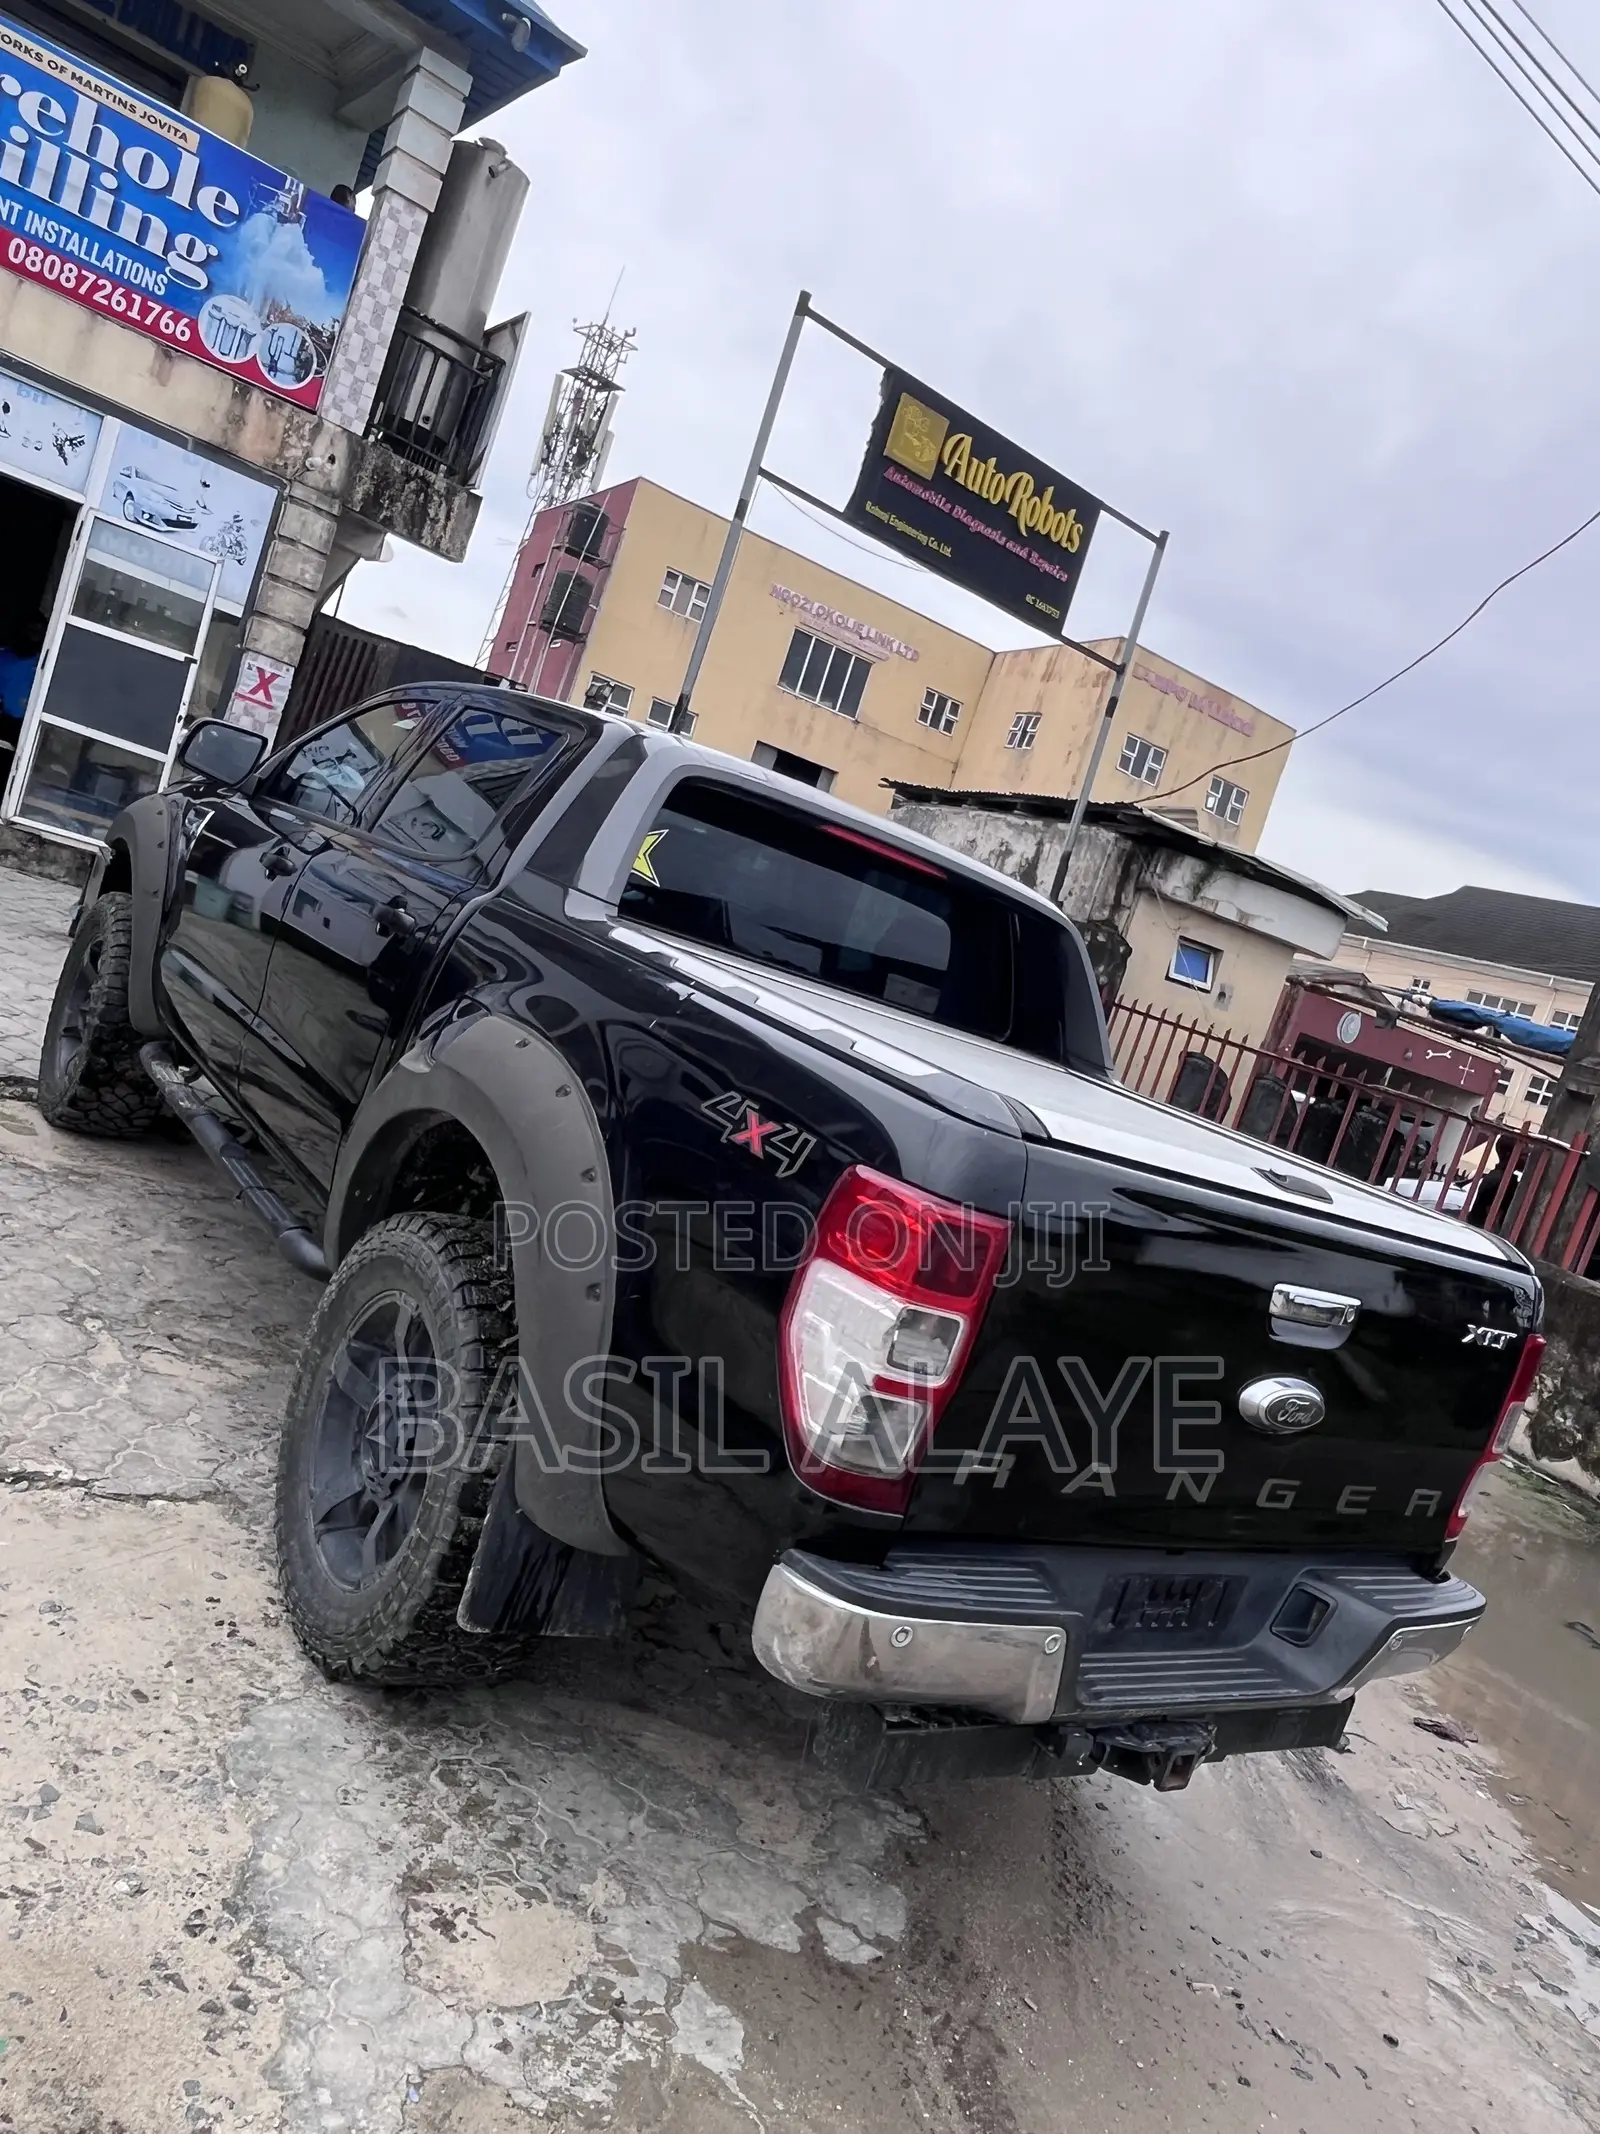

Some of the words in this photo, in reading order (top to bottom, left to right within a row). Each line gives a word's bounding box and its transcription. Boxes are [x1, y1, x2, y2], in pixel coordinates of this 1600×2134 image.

[0, 32, 43, 62] ORKS
[47, 59, 68, 76] OF
[70, 72, 137, 115] MARTINS
[139, 110, 190, 143] JOVITA
[8, 237, 191, 342] 08087261766
[24, 211, 168, 296] INSTALLATIONS
[884, 466, 951, 513] Automobile
[952, 505, 1005, 547] Diagnosis
[1006, 539, 1029, 560] and
[1029, 550, 1068, 583] Repairs
[889, 514, 928, 545] Engineering
[1276, 1397, 1320, 1425] Ford
[953, 1449, 1443, 1518] RANGER
